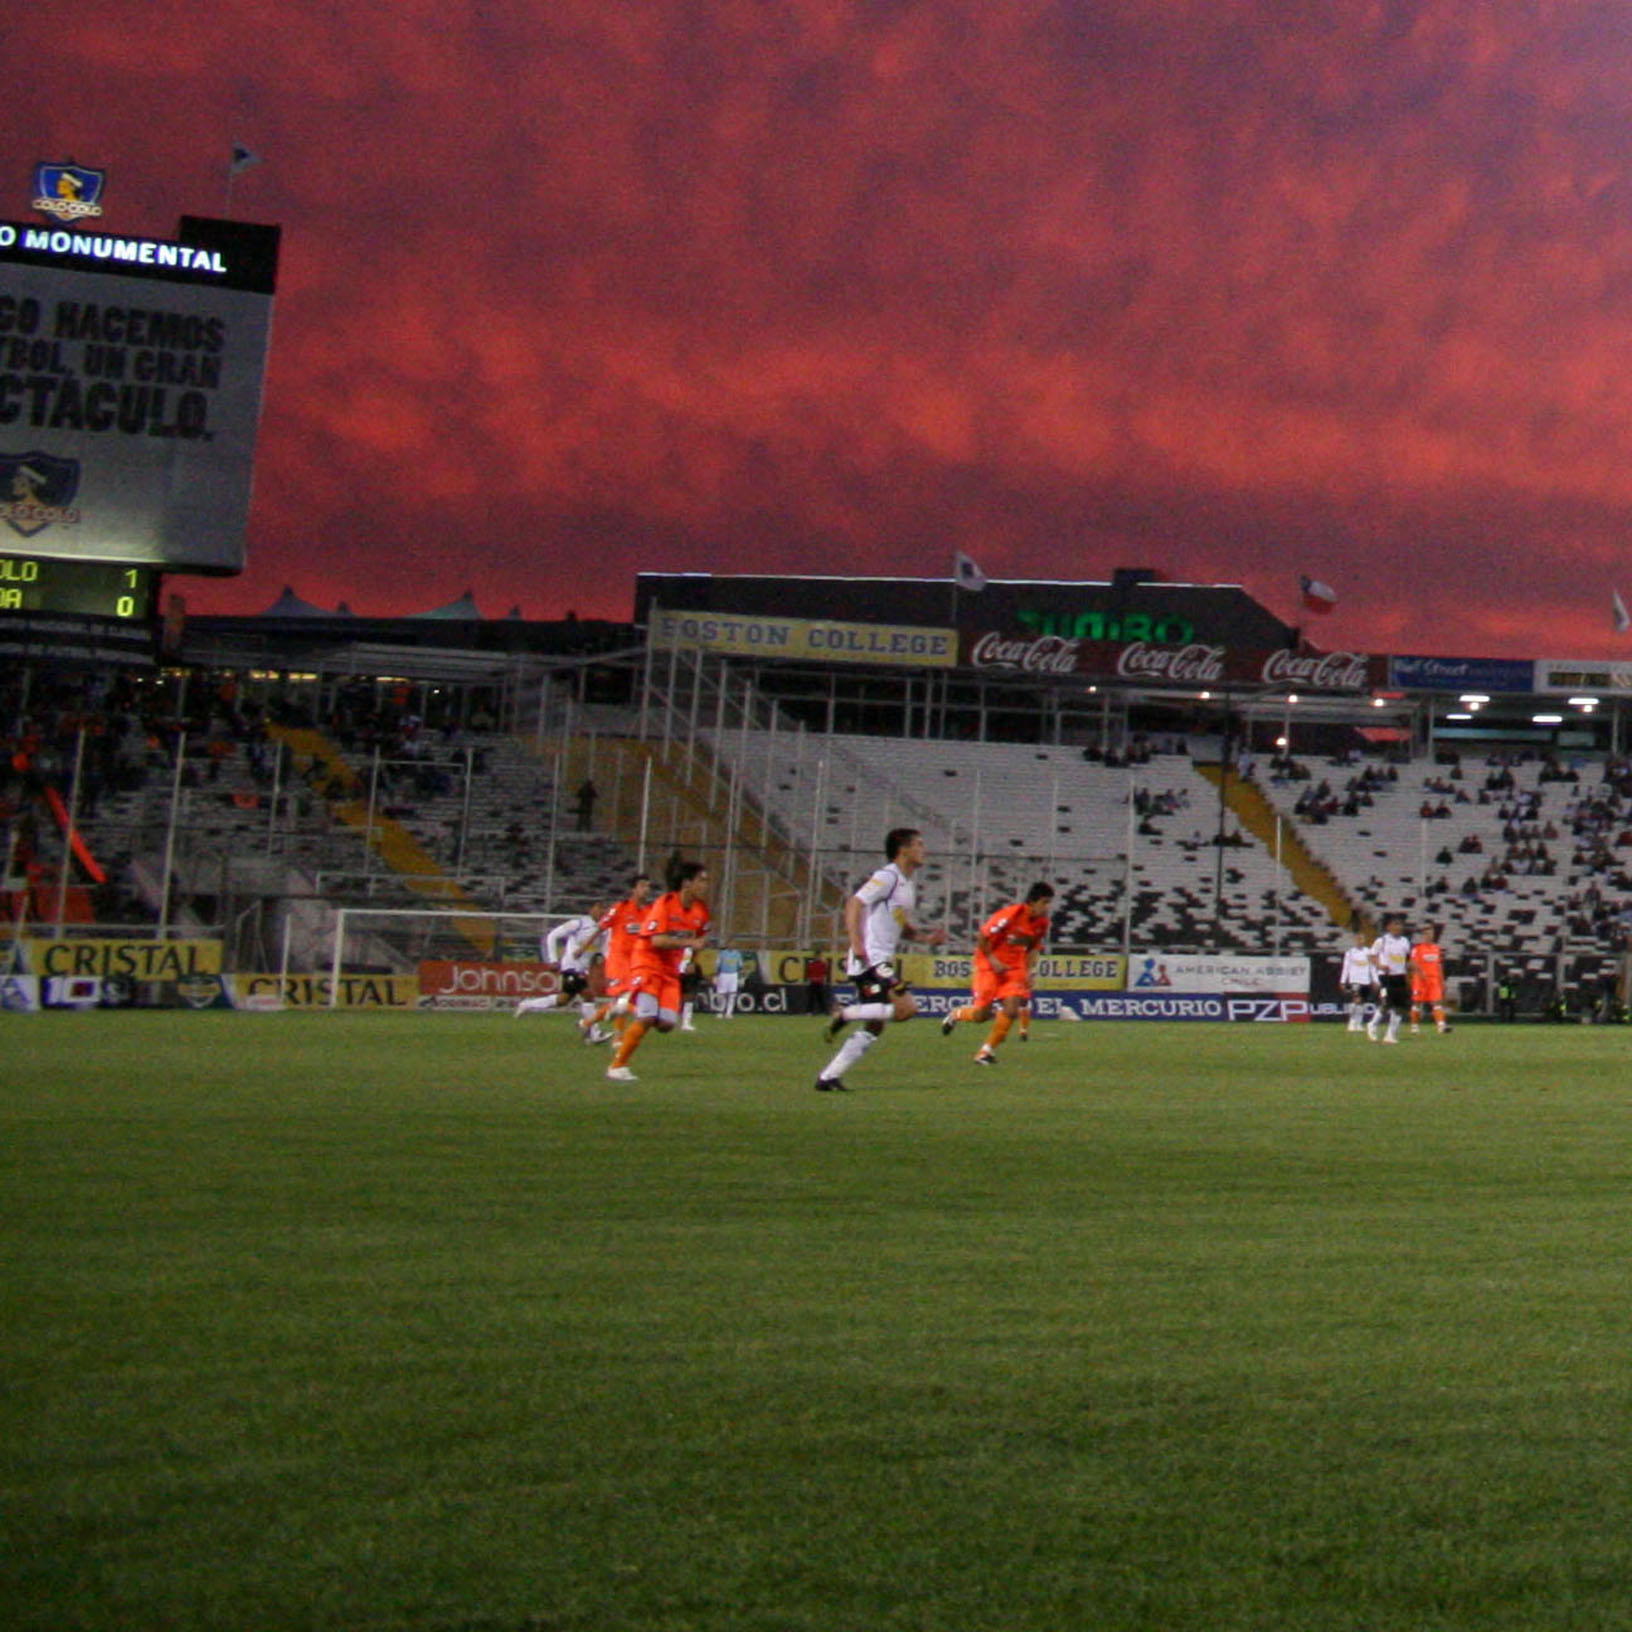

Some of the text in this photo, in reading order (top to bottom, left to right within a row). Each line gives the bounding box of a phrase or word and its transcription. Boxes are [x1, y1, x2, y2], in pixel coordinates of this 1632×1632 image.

[25, 229, 227, 272] MONUMENTAL
[55, 301, 225, 353] HACEMOS
[125, 569, 138, 589] 1
[660, 618, 949, 656] BOSTON COLLEGE
[45, 944, 207, 976] CRISTAL
[1031, 960, 1118, 979] OLLEGE
[250, 977, 407, 1006] CRISTAL
[440, 965, 563, 994] Johnso
[1080, 998, 1222, 1017] MERCURIO
